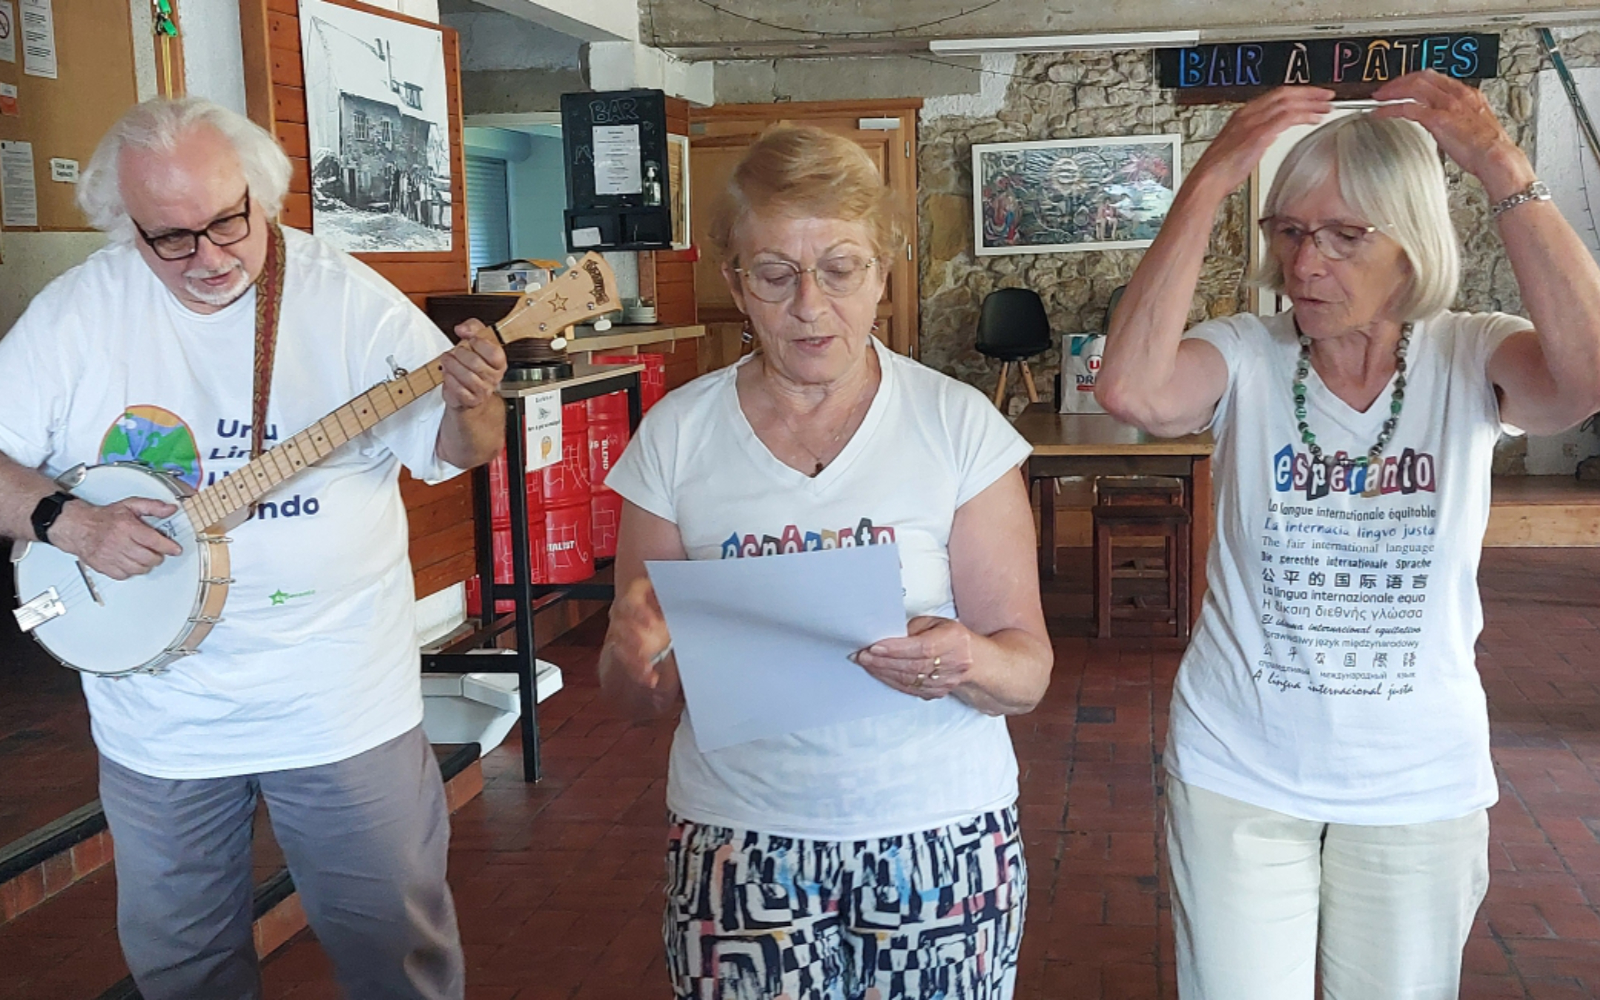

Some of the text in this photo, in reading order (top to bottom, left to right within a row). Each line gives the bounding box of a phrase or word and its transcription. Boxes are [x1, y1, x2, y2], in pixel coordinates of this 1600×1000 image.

[1179, 36, 1480, 87] BAR À PÂTES
[589, 98, 640, 124] BAR
[1275, 447, 1434, 499] esperanto
[1280, 502, 1314, 518] langue
[1316, 506, 1385, 522] internationale
[1388, 504, 1436, 522] équitable
[1264, 517, 1436, 542] La internacia lingvo justa
[1261, 535, 1435, 555] The fair international language
[1395, 558, 1432, 570] Sprache
[1261, 567, 1429, 590] 公平的国际语言
[1273, 585, 1308, 602] lingua
[1311, 589, 1394, 603] internazionale
[1397, 593, 1426, 605] equa
